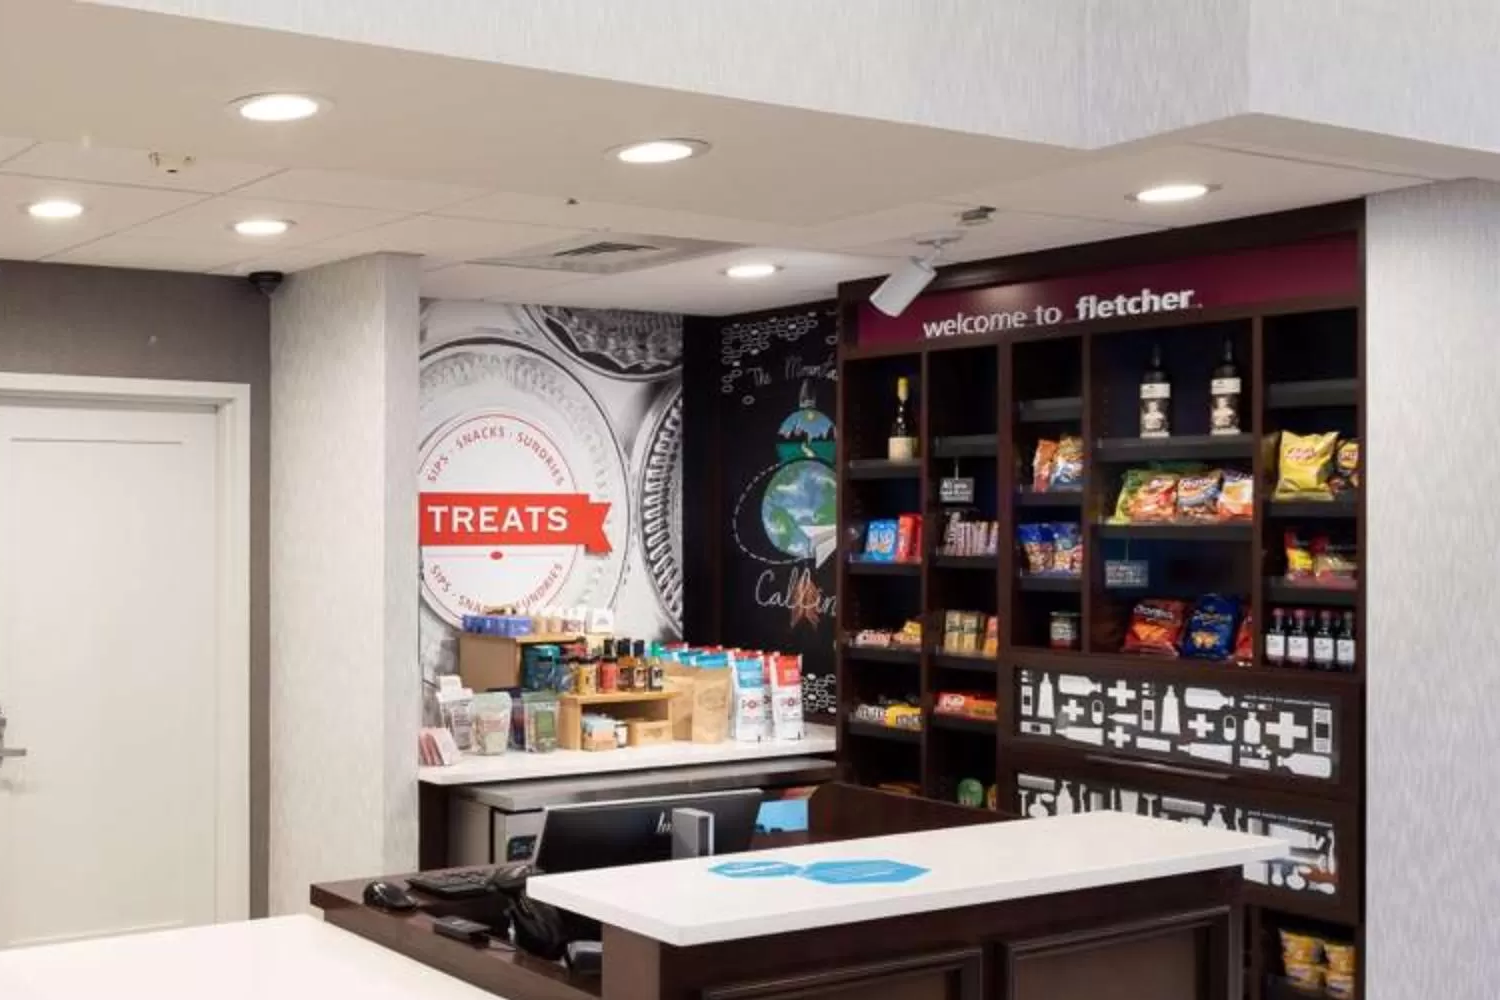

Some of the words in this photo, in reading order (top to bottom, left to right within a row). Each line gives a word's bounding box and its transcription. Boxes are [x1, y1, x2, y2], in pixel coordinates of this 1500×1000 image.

[923, 311, 1028, 339] welcome
[1035, 305, 1063, 327] to
[427, 454, 449, 482] SIPS
[455, 425, 506, 450] SNACKS
[516, 431, 565, 487] SUNDRIES
[427, 504, 569, 533] TREATS
[430, 564, 450, 592] SIPS
